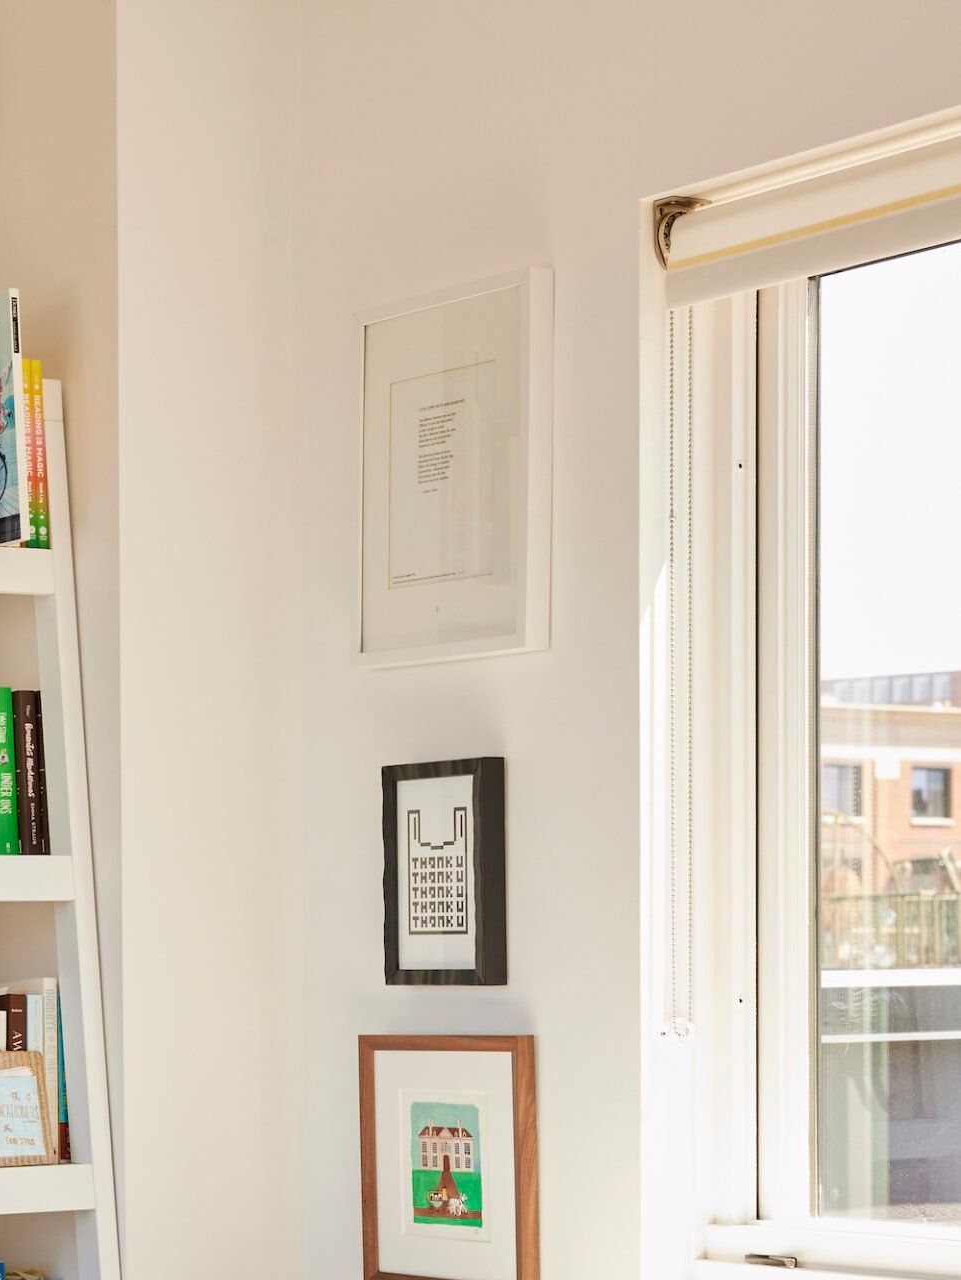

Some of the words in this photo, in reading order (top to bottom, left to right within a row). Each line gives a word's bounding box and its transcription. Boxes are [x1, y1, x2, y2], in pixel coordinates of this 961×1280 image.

[34, 395, 43, 435] READING
[36, 448, 45, 478] MAGIC
[412, 856, 453, 869] THANK
[456, 855, 464, 868] U
[412, 871, 453, 884] THANK
[456, 870, 464, 883] U
[412, 886, 453, 899] THANK
[456, 885, 464, 898] U
[412, 901, 453, 914] THANK
[456, 900, 464, 913] U
[412, 915, 453, 928] THANK
[456, 914, 464, 927] U
[45, 988, 56, 1033] GOODBYE
